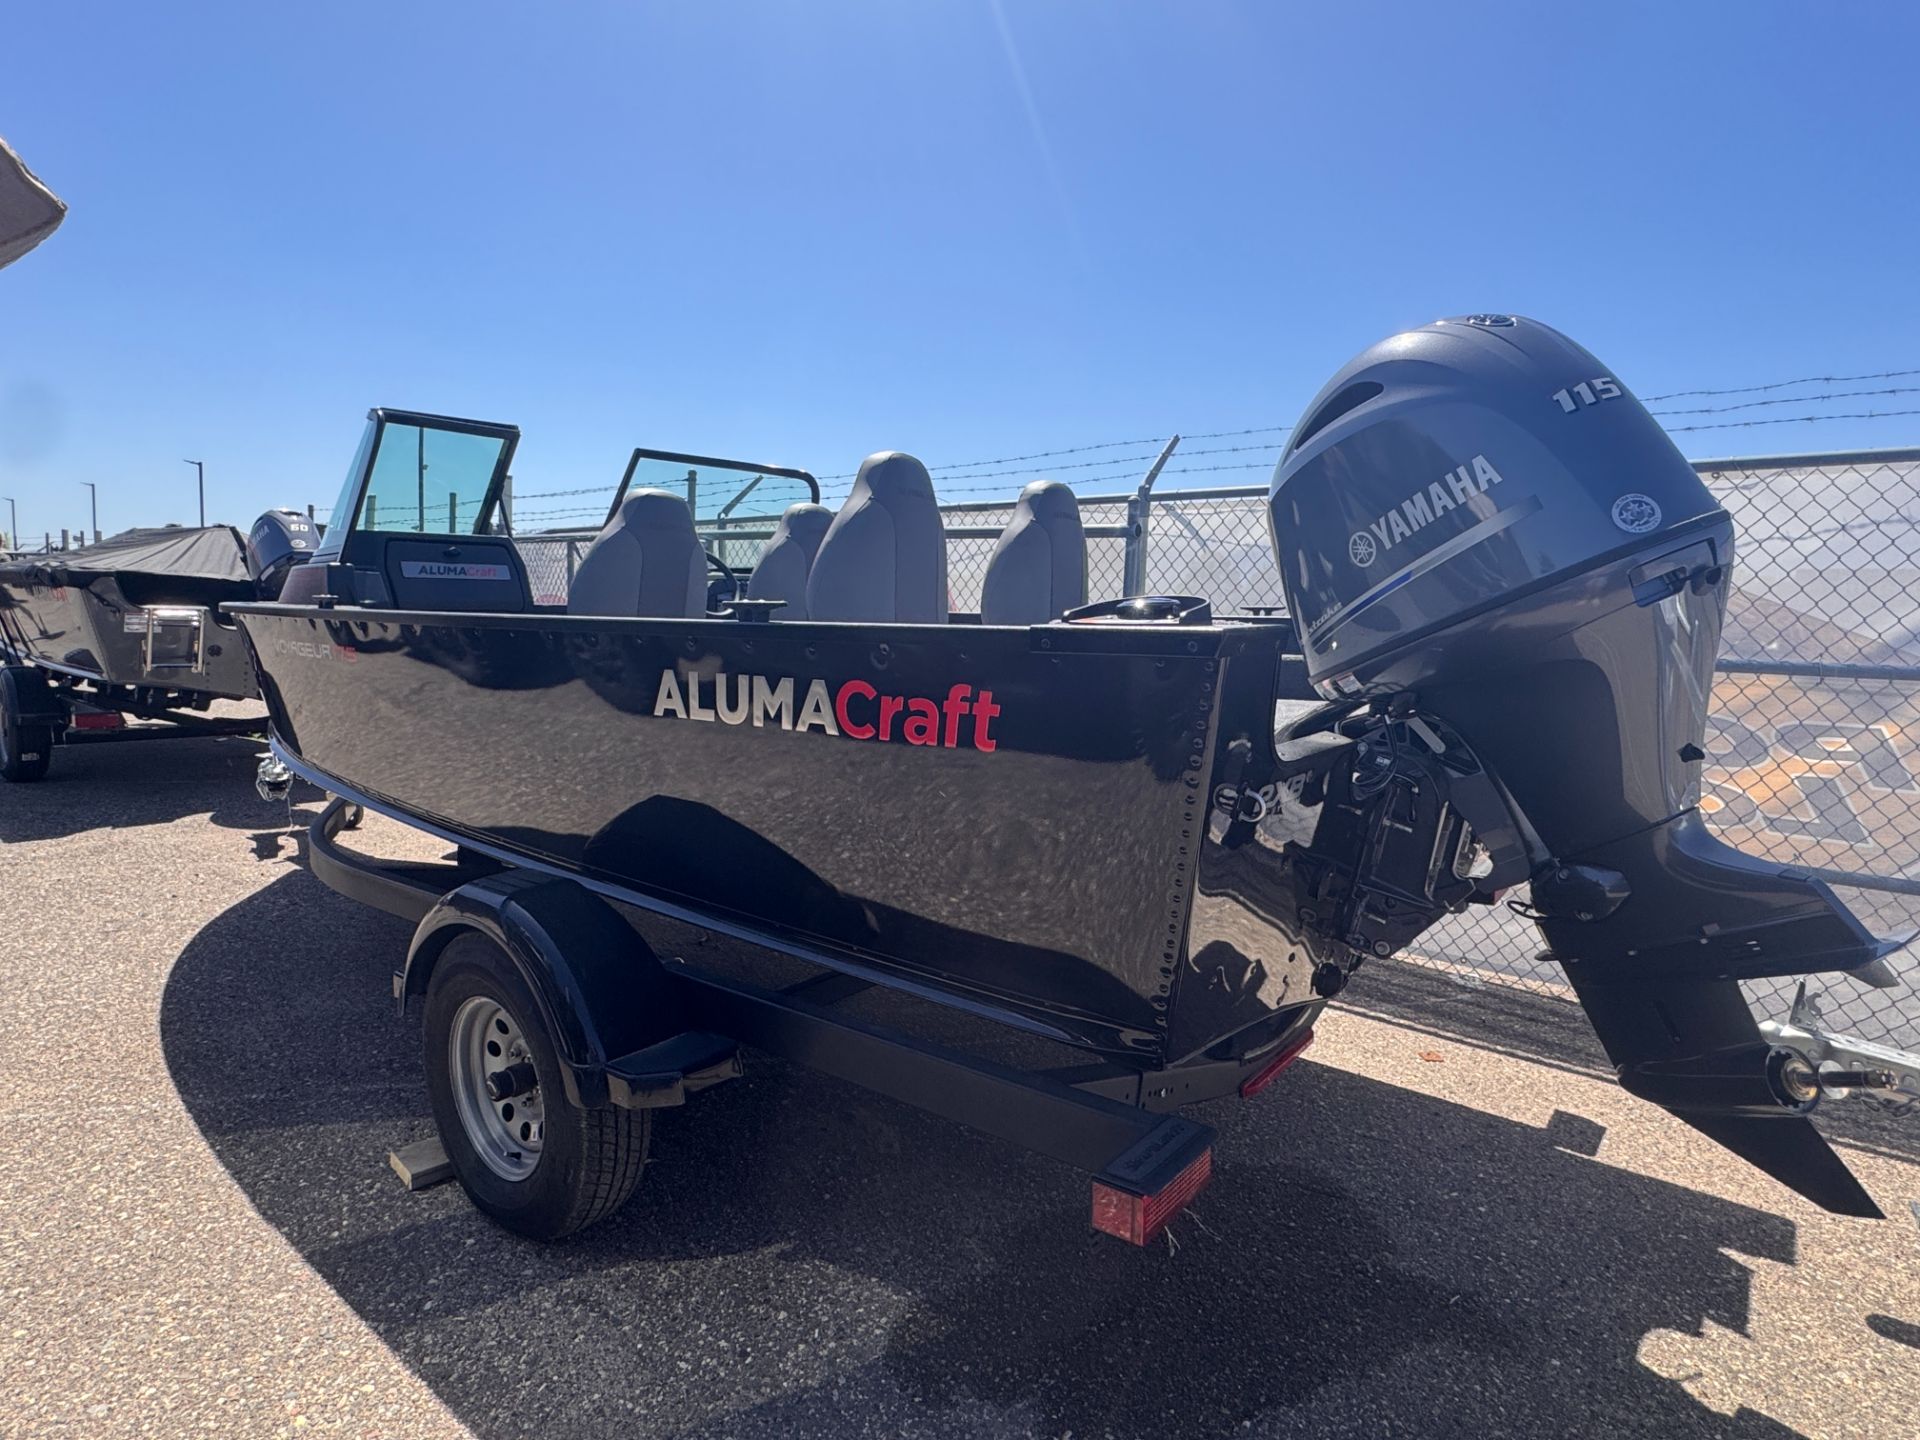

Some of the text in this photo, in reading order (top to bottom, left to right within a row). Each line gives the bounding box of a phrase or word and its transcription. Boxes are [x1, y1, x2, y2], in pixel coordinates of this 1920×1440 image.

[1552, 377, 1625, 414] 115
[1370, 454, 1505, 551] YAMAHA
[417, 564, 498, 580] ALUMACraft
[652, 668, 1002, 753] ALUMACraft
